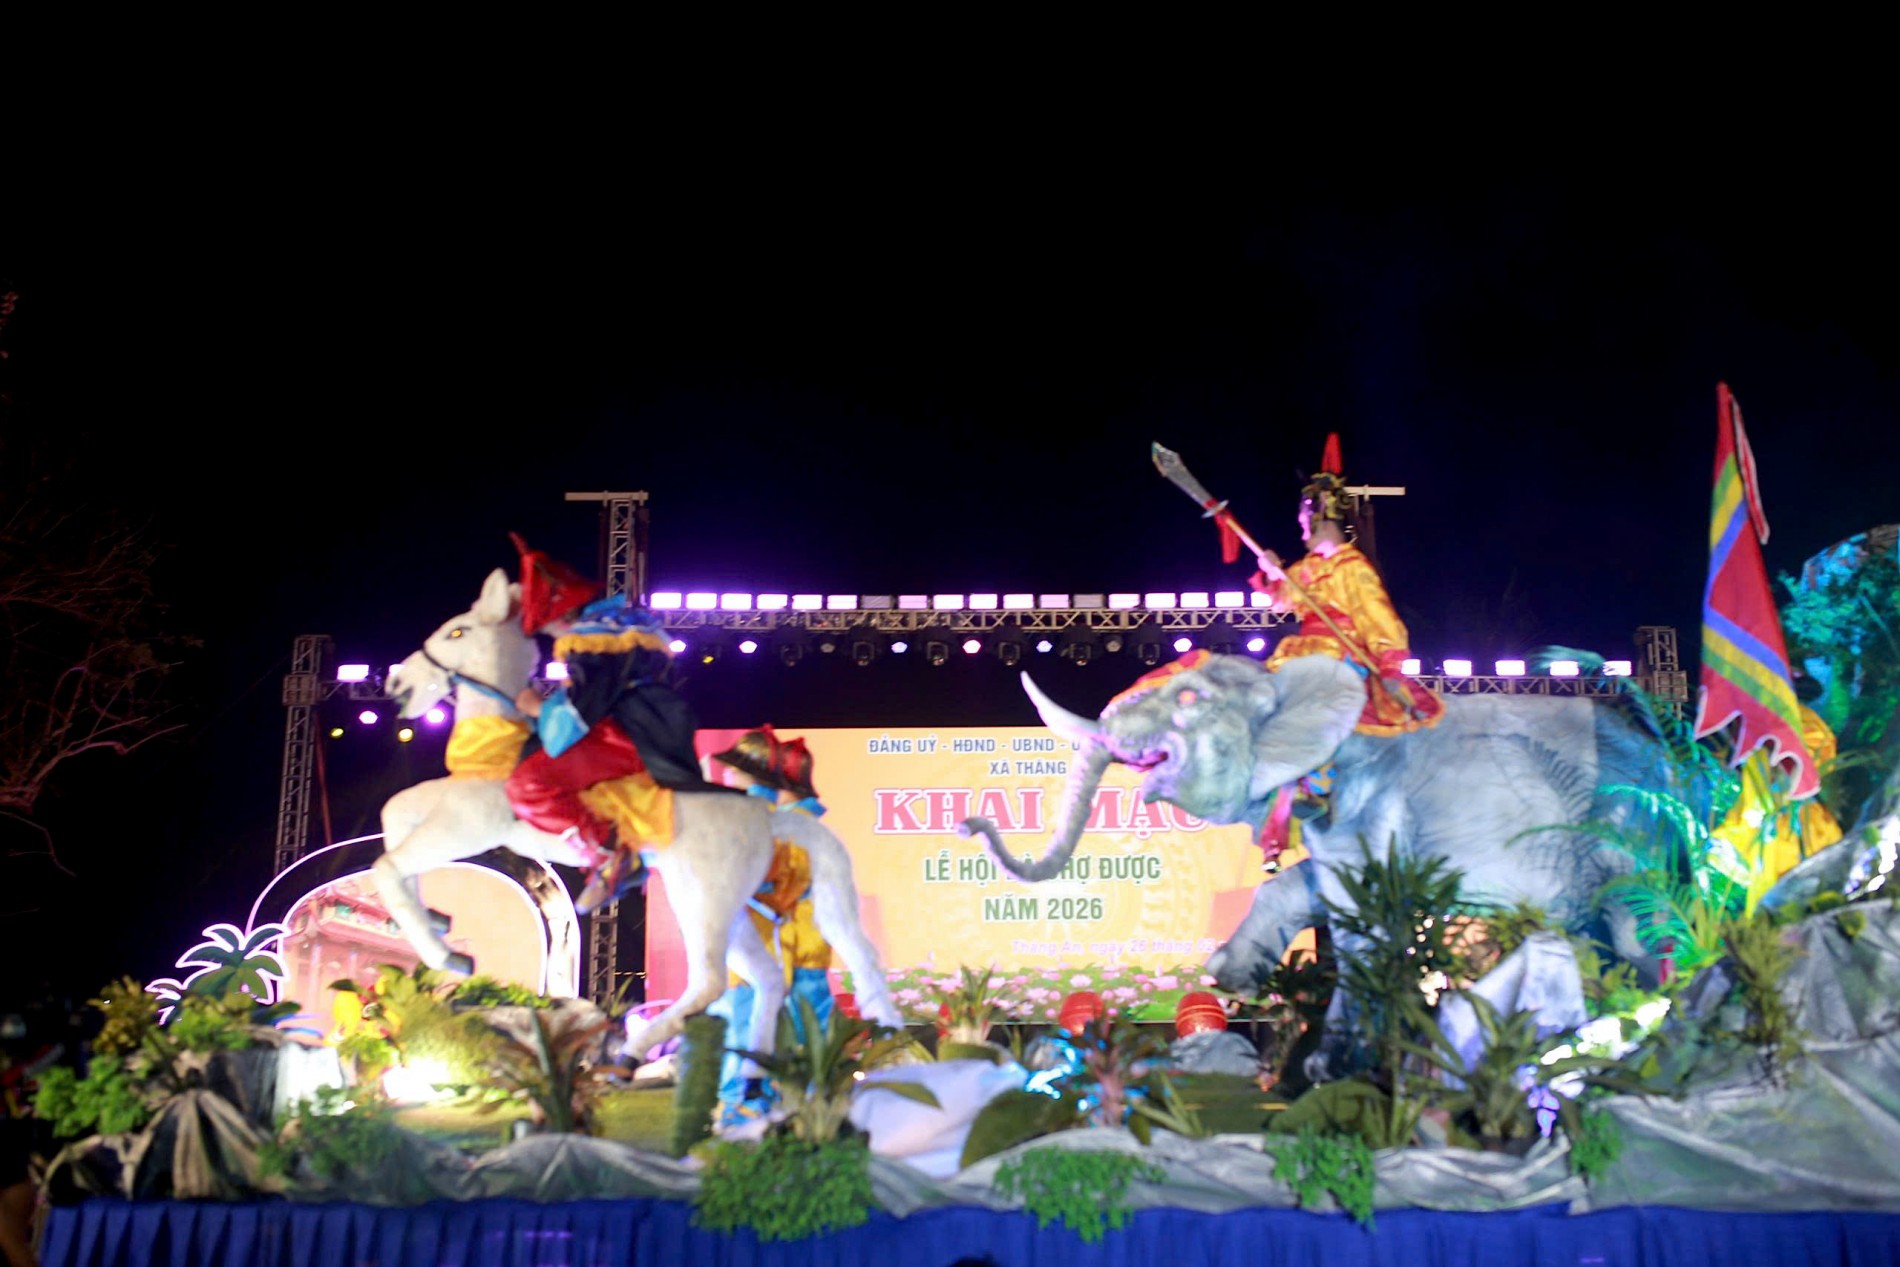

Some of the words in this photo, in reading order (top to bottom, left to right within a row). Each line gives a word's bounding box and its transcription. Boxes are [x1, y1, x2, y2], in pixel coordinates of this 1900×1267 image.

[870, 735, 912, 752] ĐẢNG
[953, 739, 995, 752] HĐND
[1013, 738, 1054, 751] UBND
[875, 788, 1044, 832] KHAI
[925, 850, 950, 881] LỄ
[959, 854, 997, 885] HỘI
[1049, 855, 1092, 885] HỢ
[1099, 855, 1161, 885] ĐƯỢC
[985, 894, 1038, 920] NĂM
[1047, 898, 1103, 920] 2026
